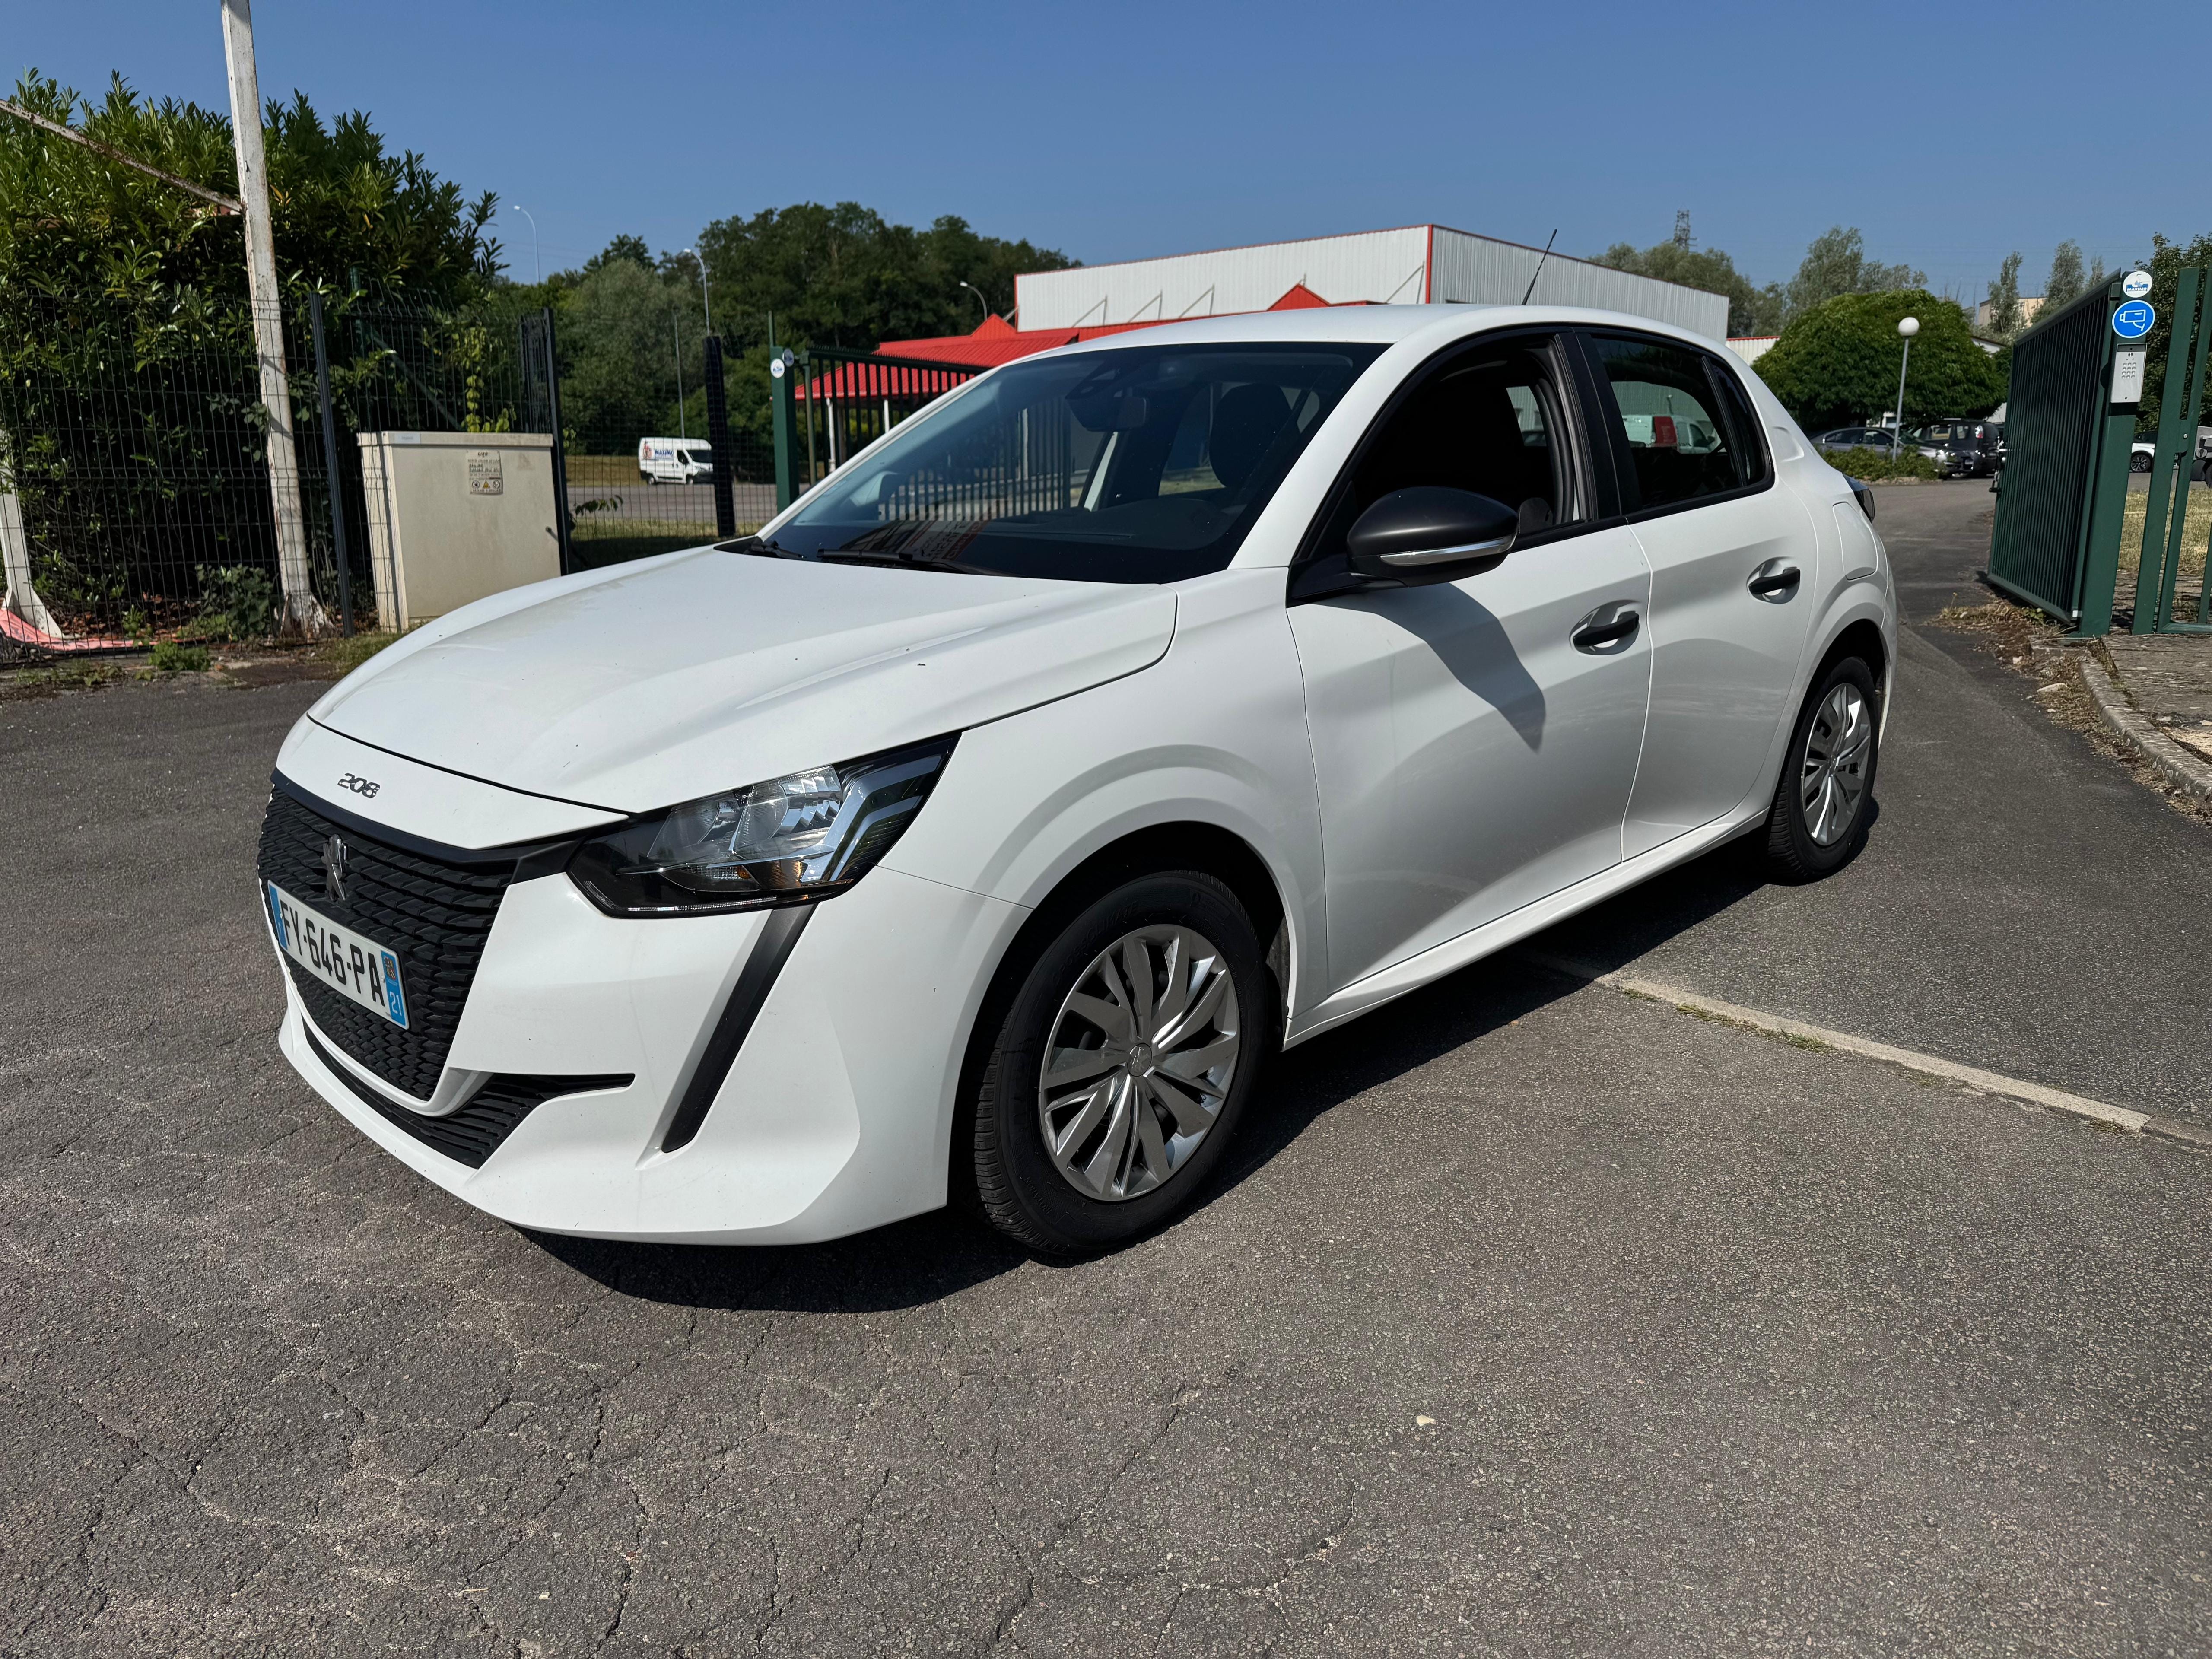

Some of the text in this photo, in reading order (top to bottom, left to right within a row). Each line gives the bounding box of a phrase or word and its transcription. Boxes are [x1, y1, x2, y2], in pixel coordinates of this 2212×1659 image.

[337, 772, 380, 798] 208
[280, 899, 385, 1007] FY-646-PA
[390, 991, 402, 1017] 21
